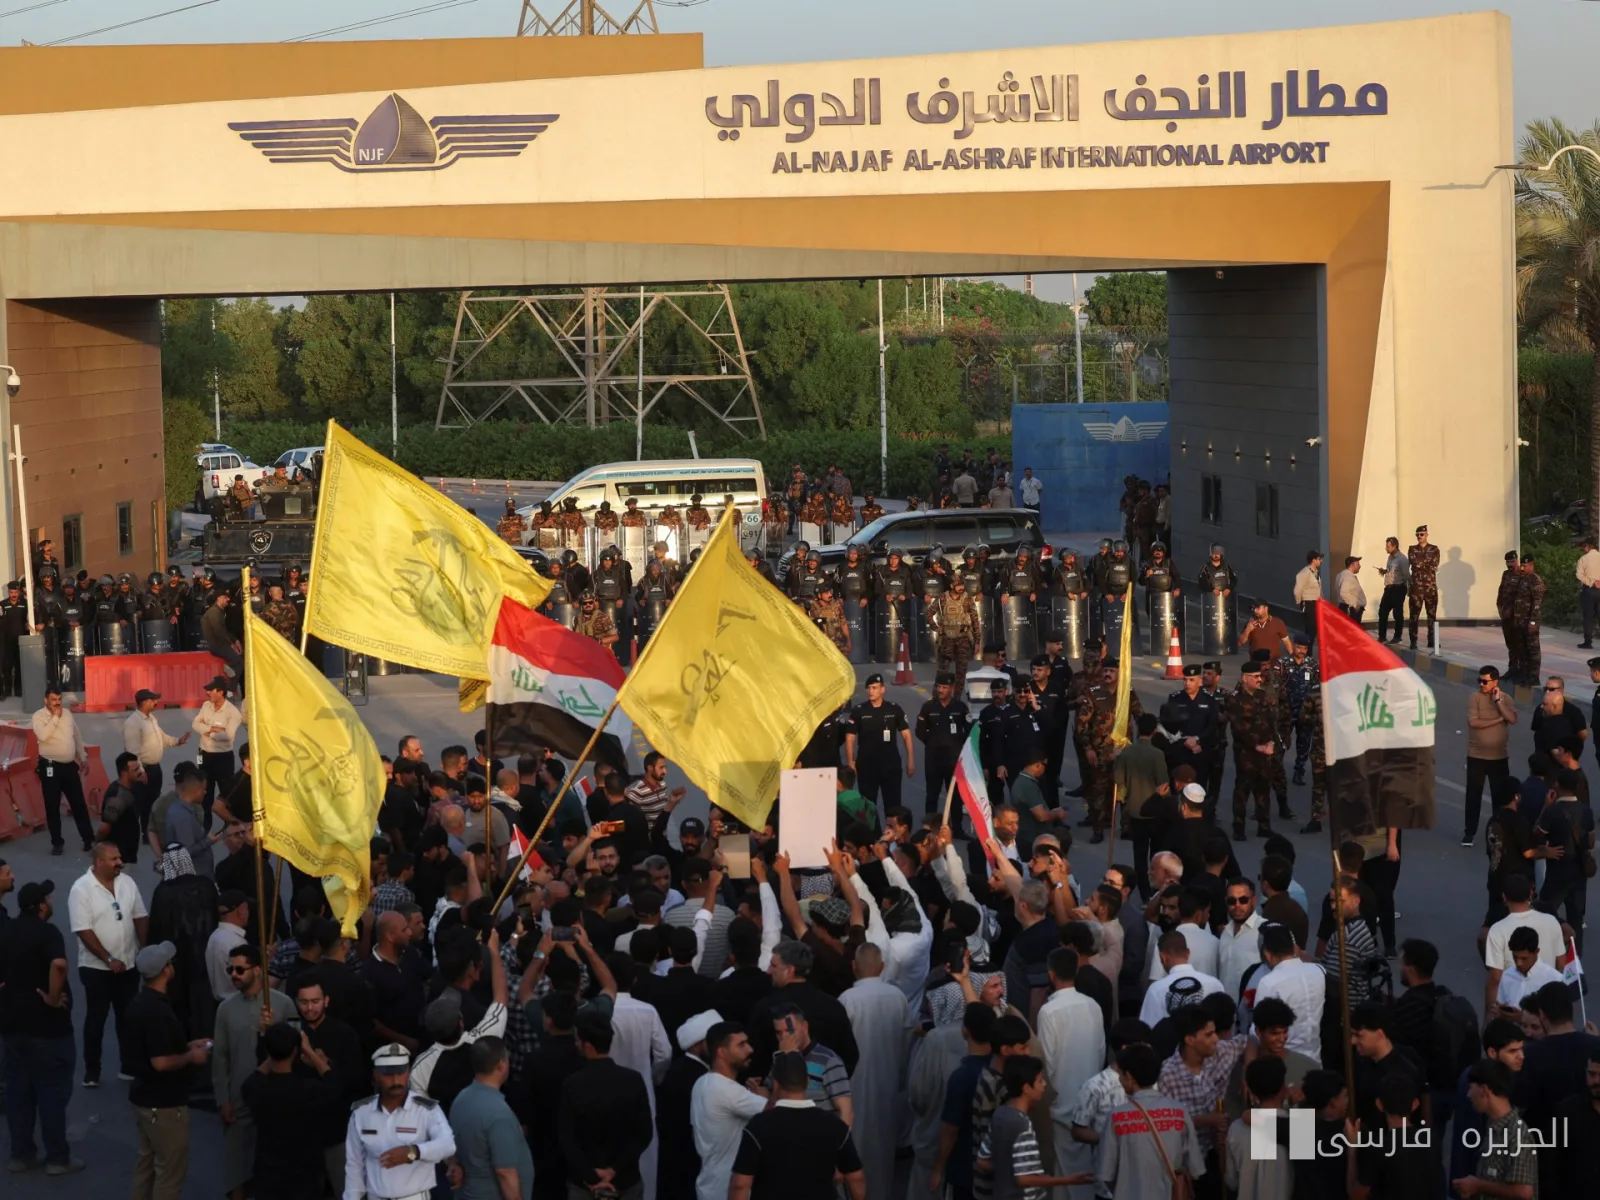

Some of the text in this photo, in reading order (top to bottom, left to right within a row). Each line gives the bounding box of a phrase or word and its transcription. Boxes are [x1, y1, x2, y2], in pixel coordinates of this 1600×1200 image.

[705, 69, 1388, 143] مطار النجف الاشرف الدولي
[358, 147, 385, 162] NJF
[772, 141, 1330, 174] AL-NAJAF AL-ASHRAF INTERNATIONAL AIRPORT
[747, 514, 759, 523] 66
